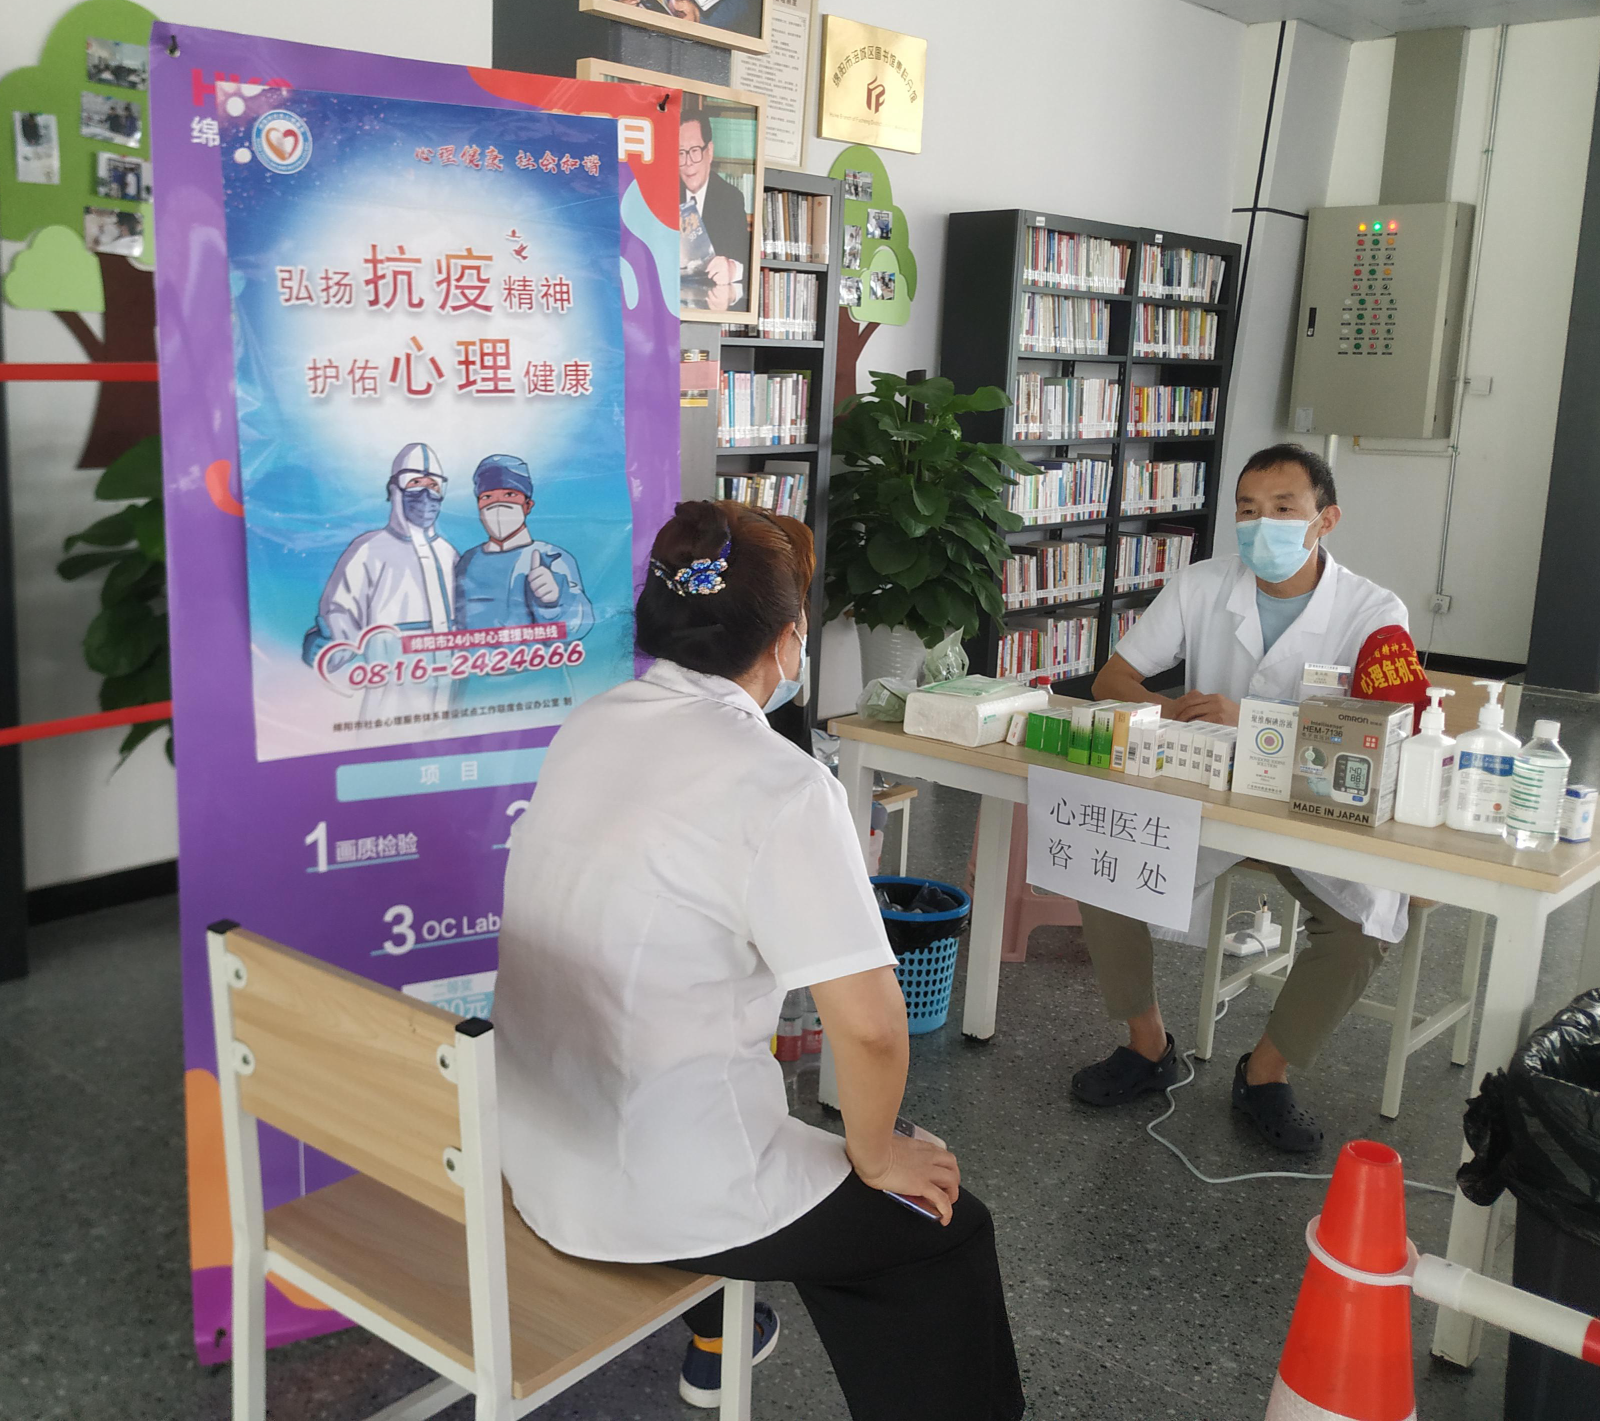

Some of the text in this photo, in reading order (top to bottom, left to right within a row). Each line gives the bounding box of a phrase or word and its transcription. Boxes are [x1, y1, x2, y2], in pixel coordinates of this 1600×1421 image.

[414, 144, 602, 177] 心理健康 社会和谐
[276, 243, 574, 314] 弘扬抗疫精神
[306, 334, 594, 398] 护佑心理健康
[410, 625, 559, 652] 绵阳市24小时心理援助热线
[348, 641, 586, 689] 0816-2424666
[1049, 797, 1171, 850] 心理医生
[1293, 801, 1370, 824] MADE IN JAPAN
[335, 832, 419, 863] 画质检验
[422, 918, 457, 941] OC
